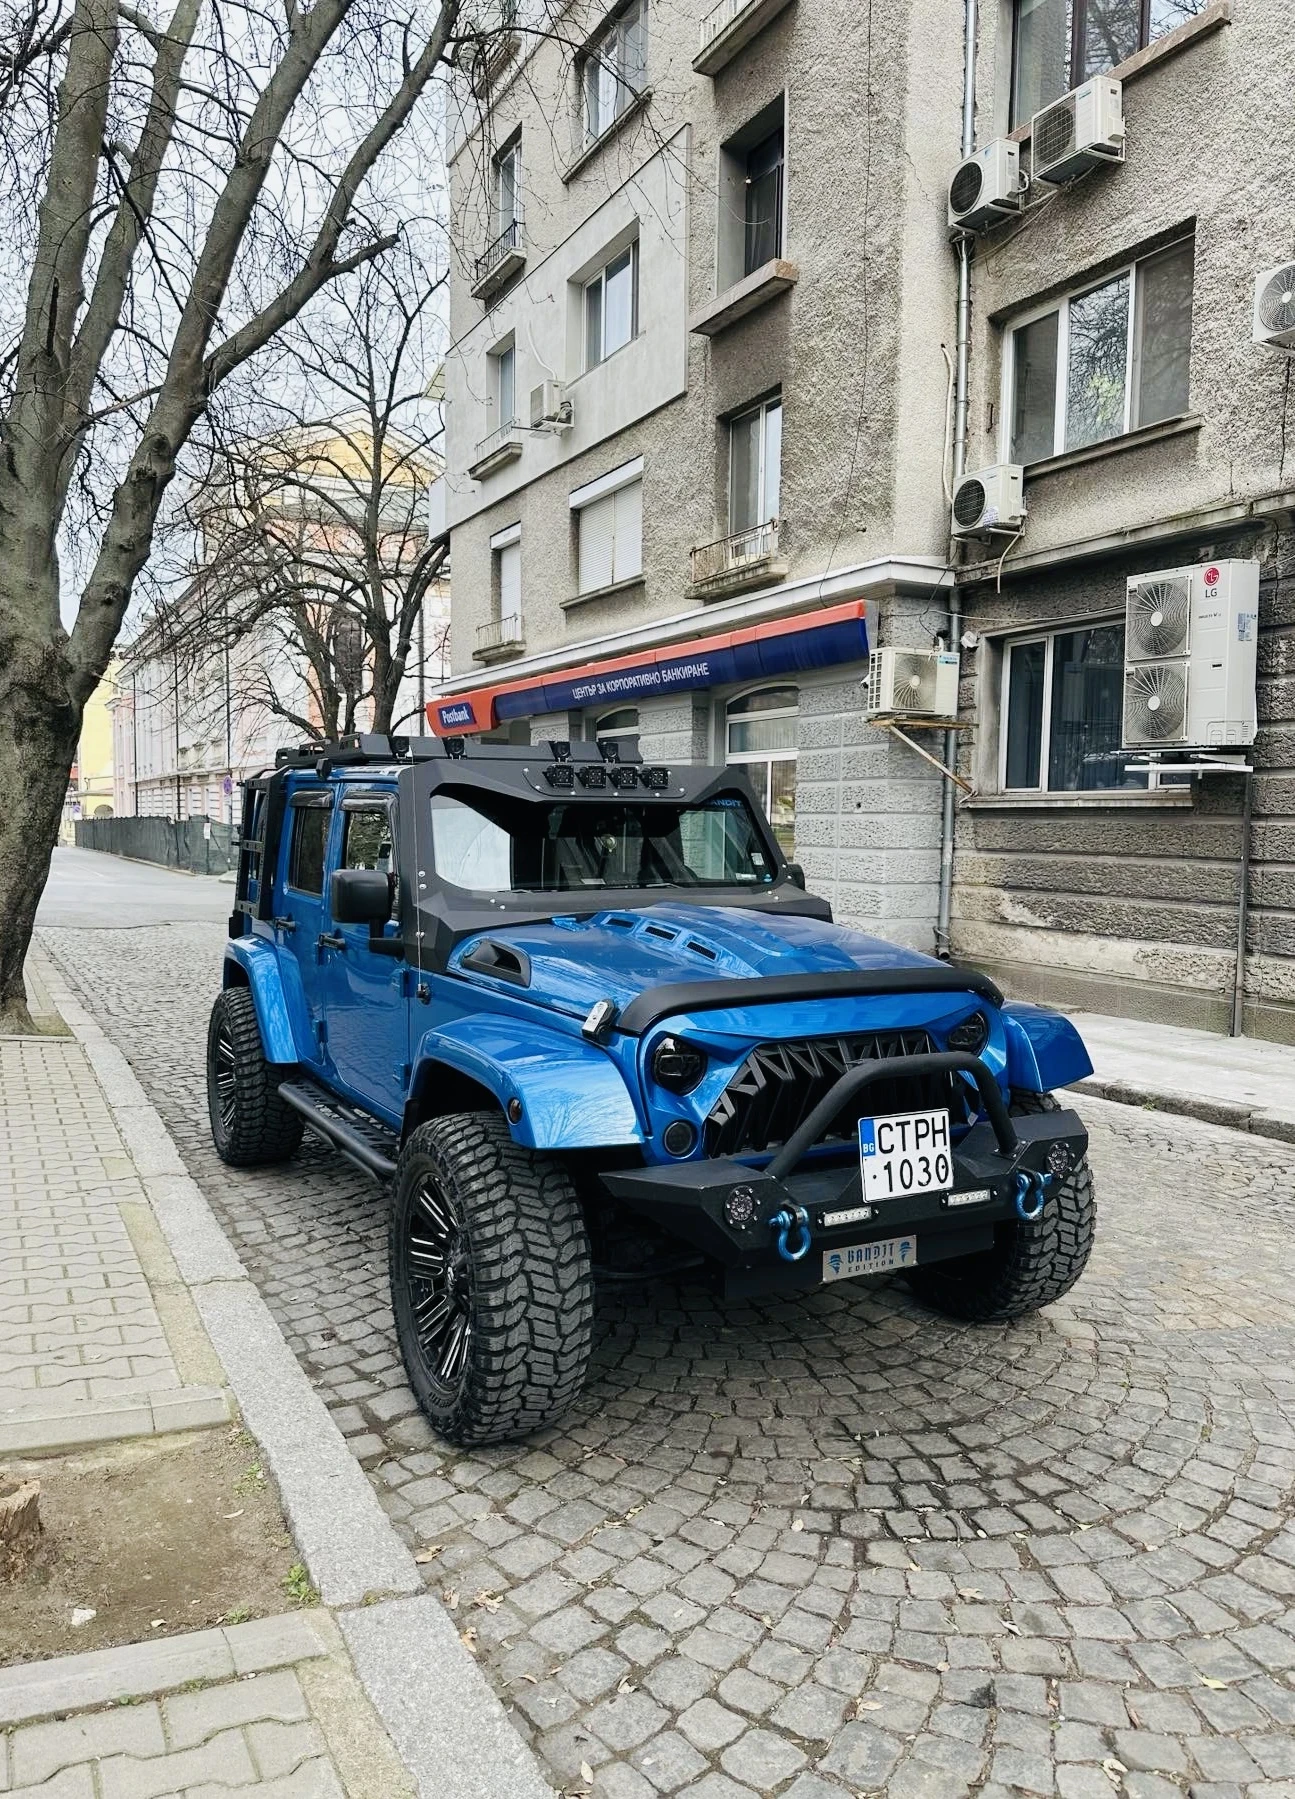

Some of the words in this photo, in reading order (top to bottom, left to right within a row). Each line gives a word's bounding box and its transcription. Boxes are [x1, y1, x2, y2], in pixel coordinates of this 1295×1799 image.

[1205, 588, 1218, 598] LG
[571, 685, 597, 701] ЦЕНТЪР
[597, 683, 607, 695] ЗА
[606, 671, 661, 693] КОРПОРАТИВНО
[661, 662, 710, 682] БАНКИРАНЕ
[441, 705, 470, 724] Postbank
[877, 1115, 947, 1154] CTPH
[863, 1143, 875, 1153] BG
[883, 1153, 950, 1193] 1030
[848, 1259, 894, 1272] EDITION
